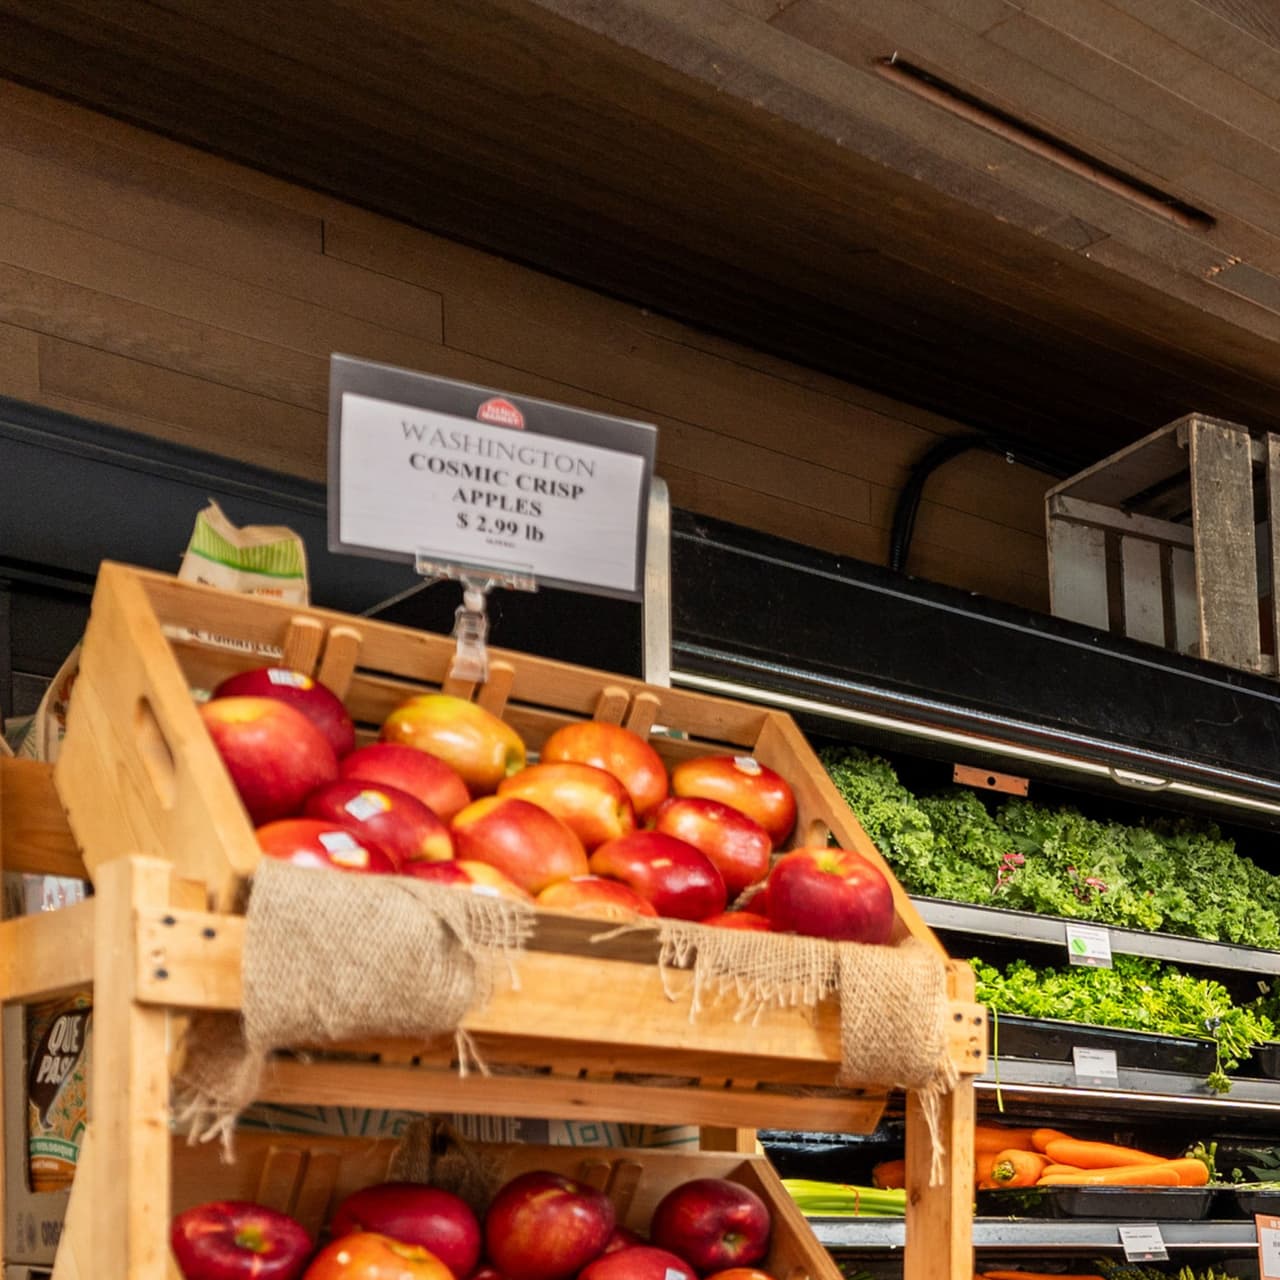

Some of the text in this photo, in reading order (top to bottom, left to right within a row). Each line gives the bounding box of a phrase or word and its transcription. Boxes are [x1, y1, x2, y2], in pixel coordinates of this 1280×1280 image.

[401, 421, 596, 478] WASHINGTON
[408, 453, 585, 501] COSMIC CRISP
[451, 487, 544, 518] APPLES
[456, 512, 545, 542] $ 2.99 lb
[48, 1015, 82, 1055] QUE
